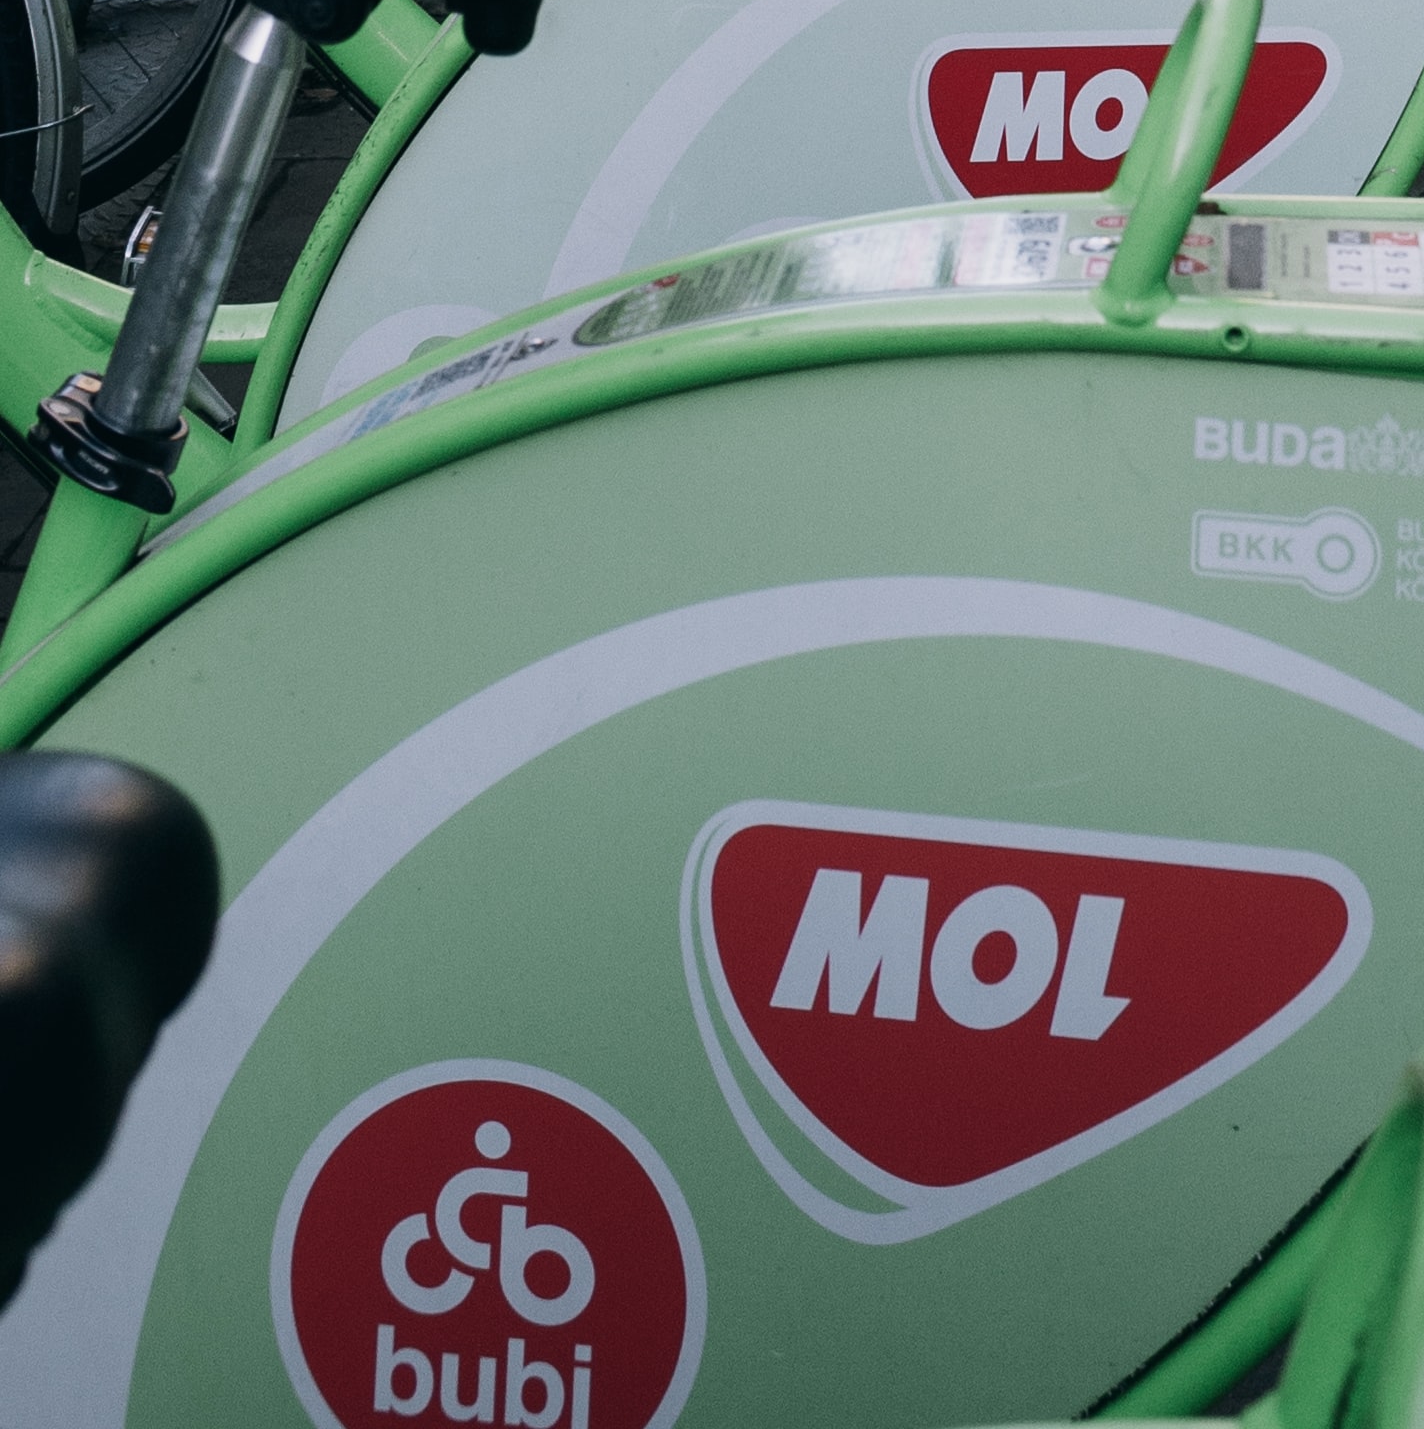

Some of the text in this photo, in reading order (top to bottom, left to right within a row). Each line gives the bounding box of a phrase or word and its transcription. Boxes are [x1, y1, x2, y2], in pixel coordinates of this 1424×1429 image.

[969, 68, 1151, 163] MO
[1217, 531, 1295, 564] BKK
[769, 867, 1132, 1041] MOL
[373, 1324, 592, 1429] bubi
